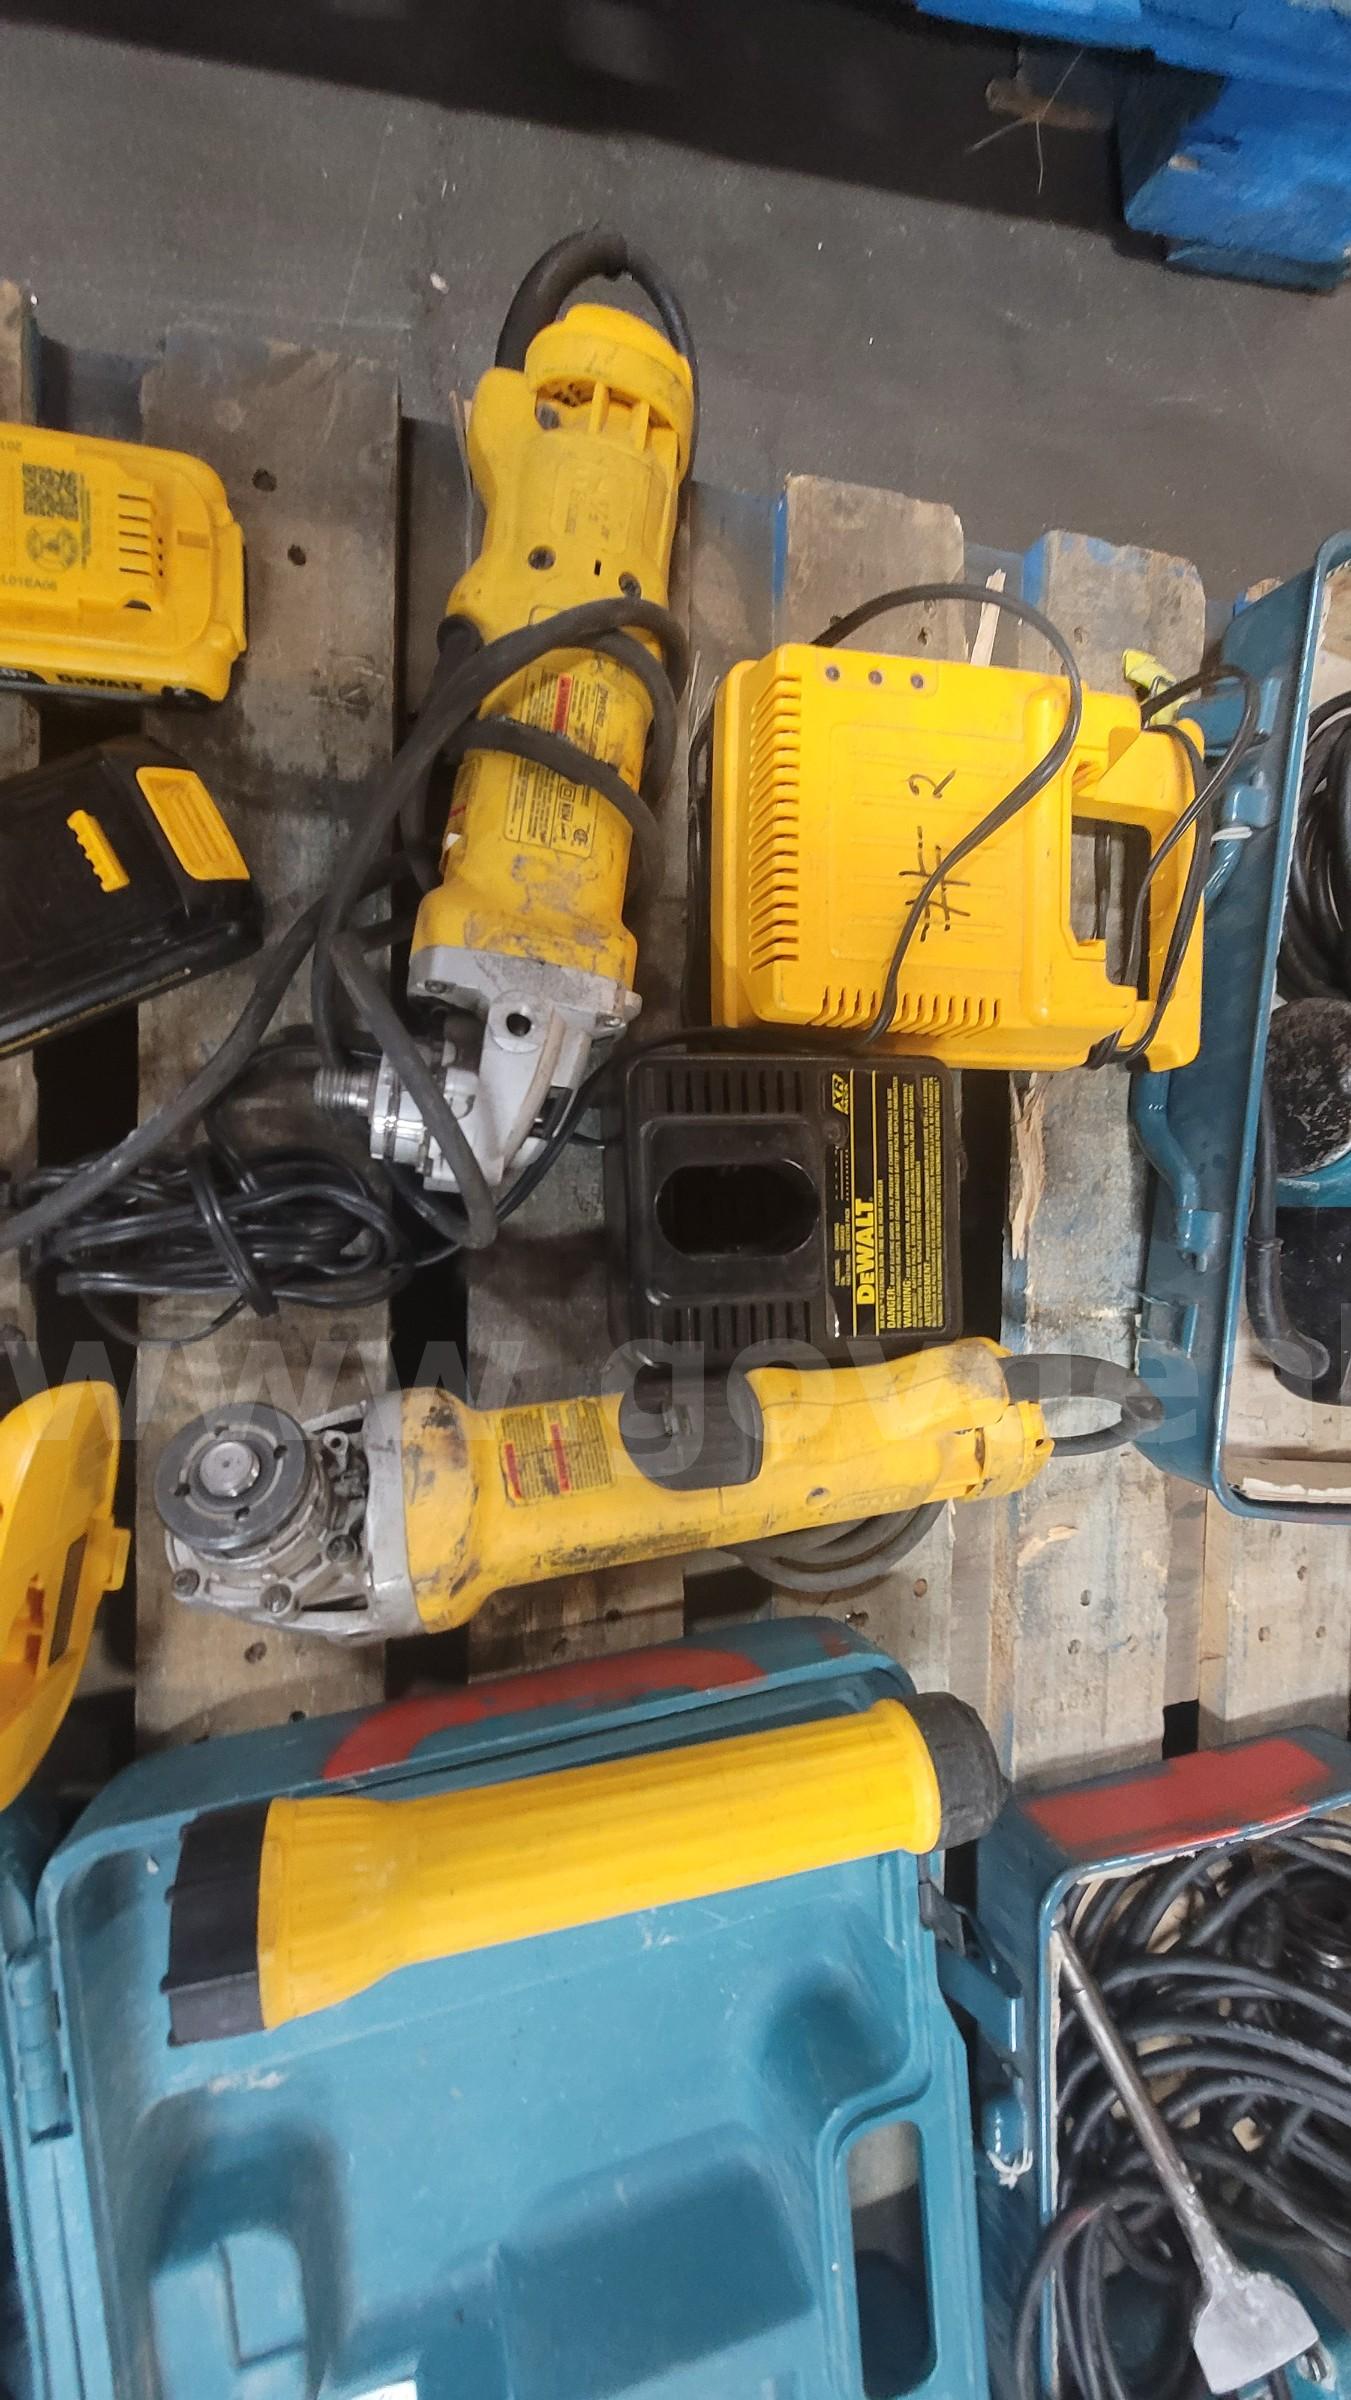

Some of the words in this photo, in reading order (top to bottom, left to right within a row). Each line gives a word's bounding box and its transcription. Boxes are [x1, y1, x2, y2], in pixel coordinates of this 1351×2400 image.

[855, 1198, 875, 1304] DEWALT
[886, 1286, 896, 1328] DANGER:
[902, 1278, 912, 1328] WARNING:
